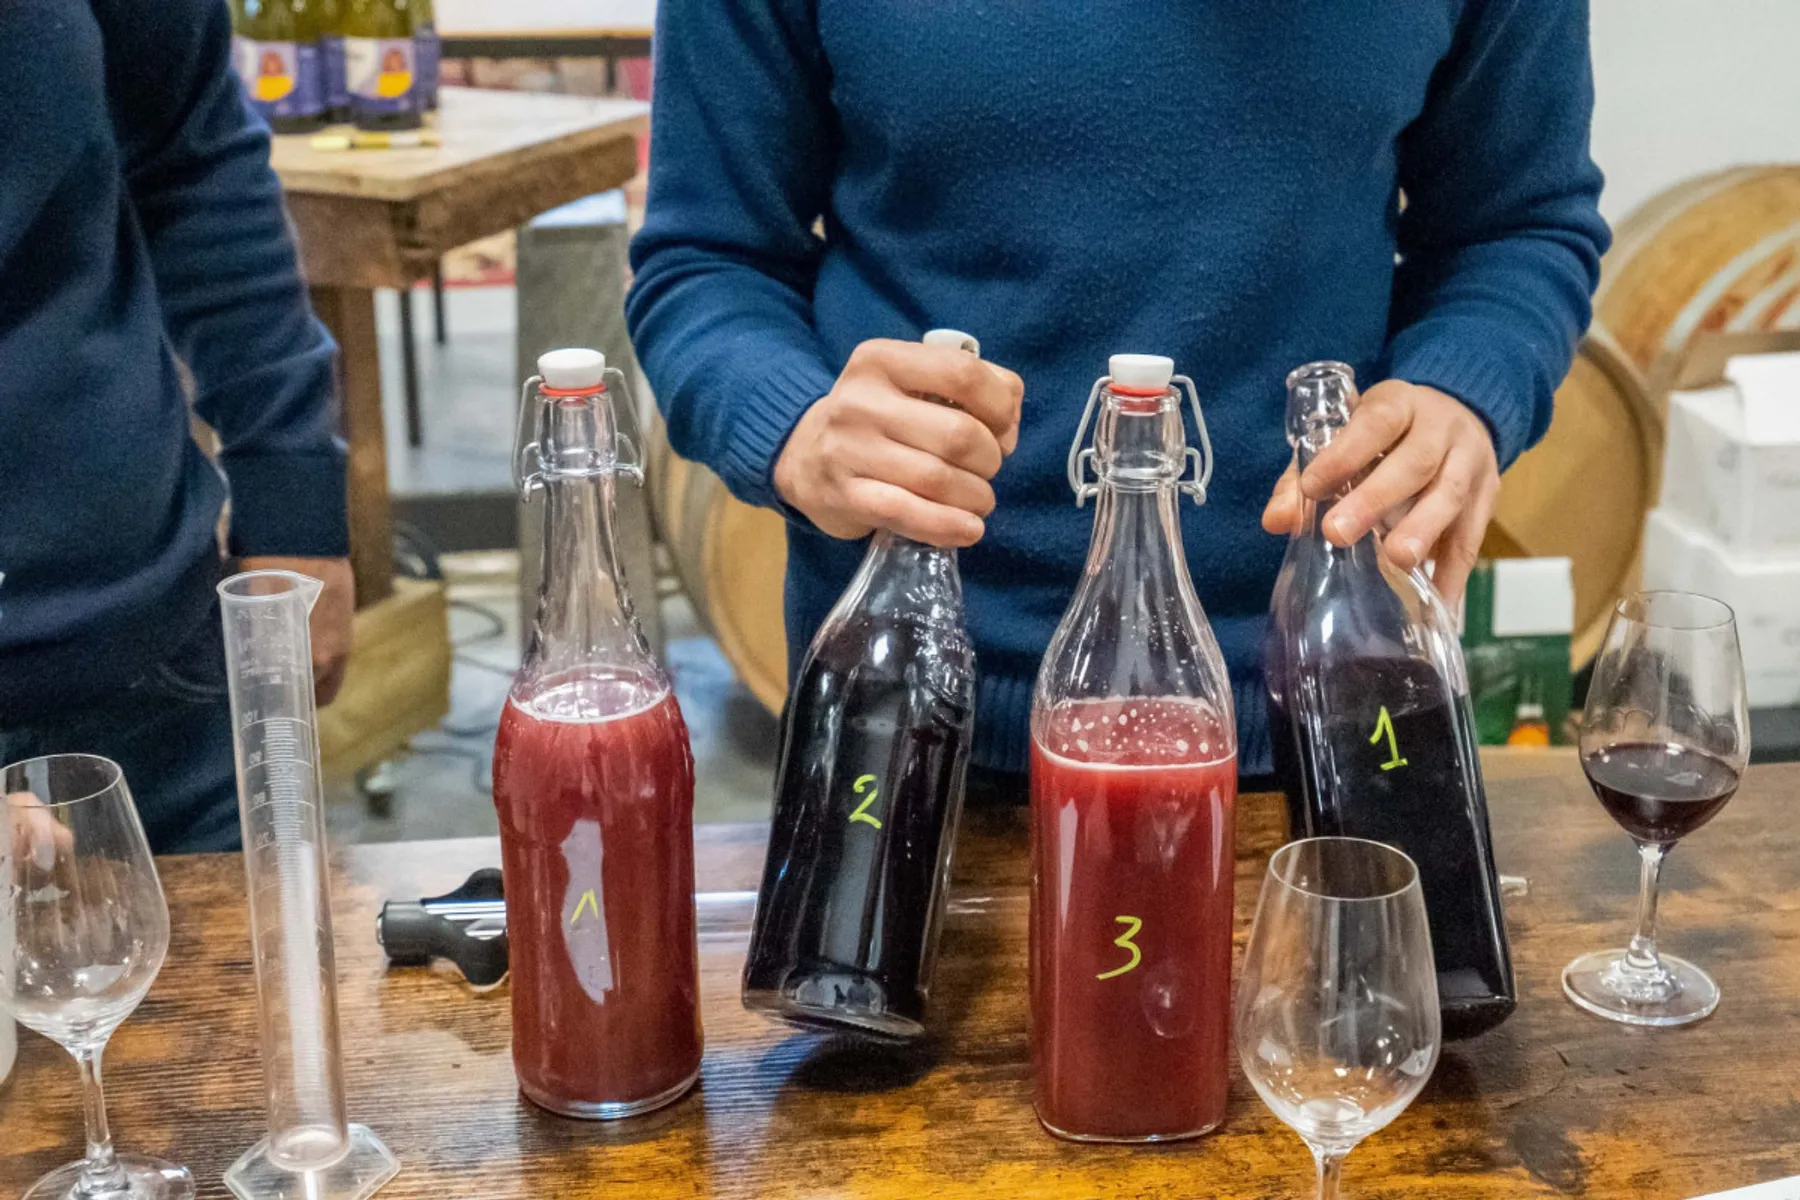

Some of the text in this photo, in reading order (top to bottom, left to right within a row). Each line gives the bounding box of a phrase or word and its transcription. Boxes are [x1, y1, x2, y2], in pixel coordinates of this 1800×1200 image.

[1369, 705, 1408, 771] 1
[848, 773, 882, 829] 2
[1095, 915, 1143, 980] 3
